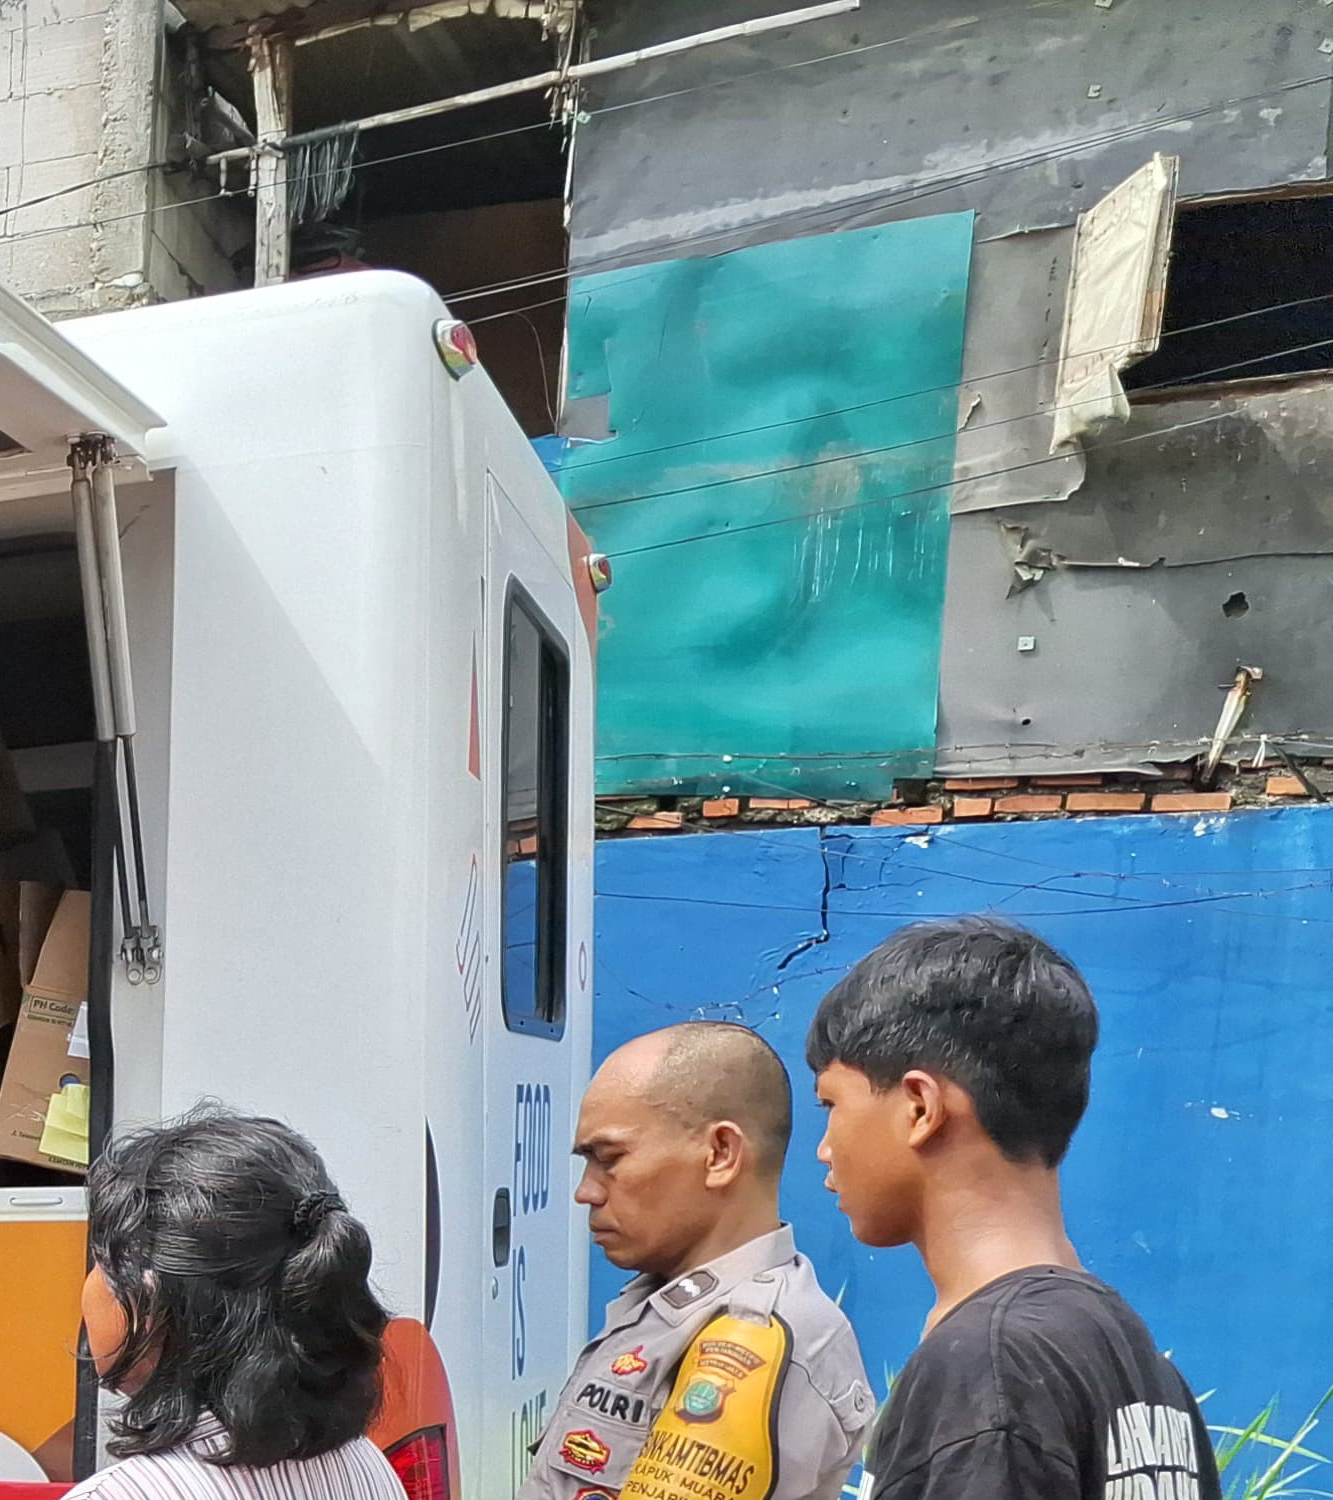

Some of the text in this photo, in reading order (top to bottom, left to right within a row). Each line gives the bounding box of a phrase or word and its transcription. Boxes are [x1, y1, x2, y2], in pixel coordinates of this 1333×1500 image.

[513, 1084, 551, 1217] FOOD
[511, 1245, 526, 1381] IS
[576, 1383, 644, 1424] POLRI
[638, 1430, 755, 1495] NKAMTIBMAS
